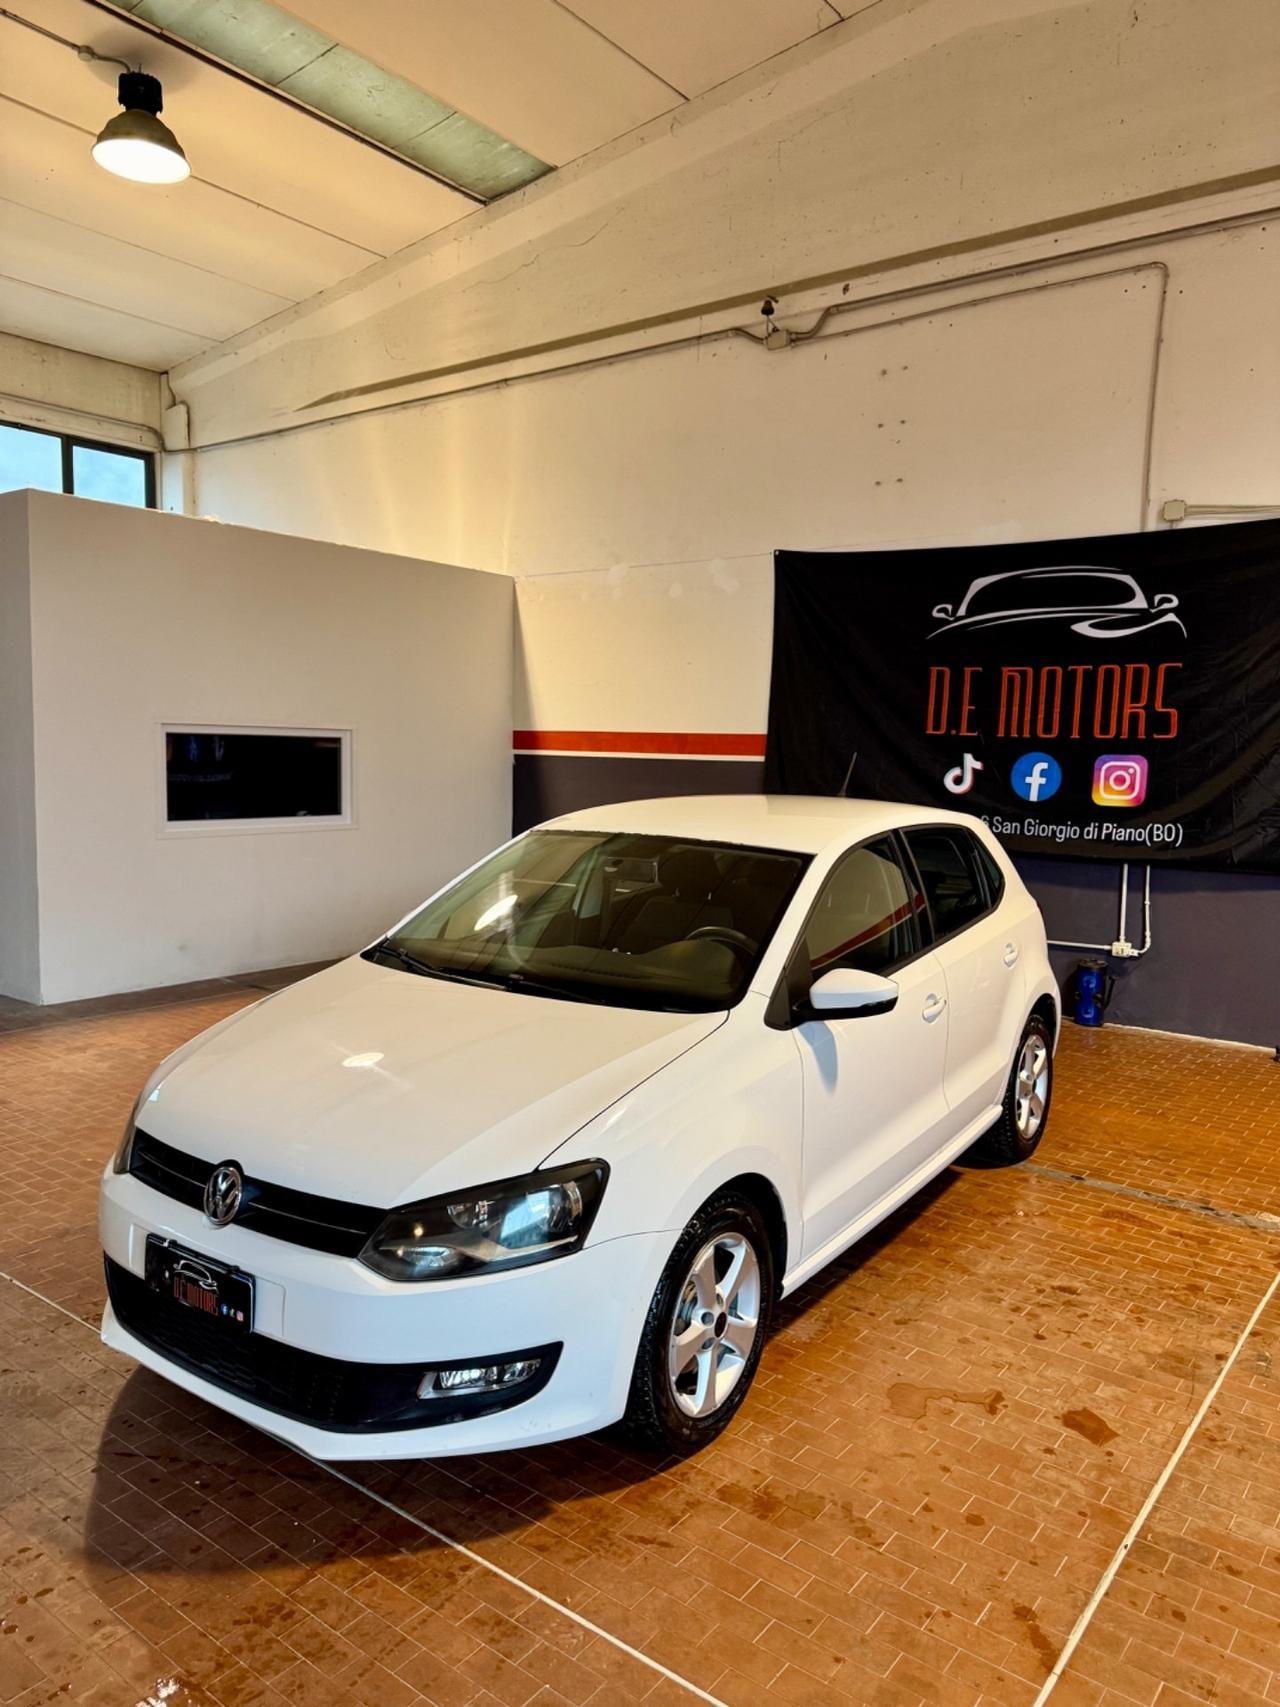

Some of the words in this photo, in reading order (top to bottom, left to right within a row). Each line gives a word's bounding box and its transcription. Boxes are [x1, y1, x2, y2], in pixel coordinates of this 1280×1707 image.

[926, 666, 982, 736] D.E
[997, 664, 1182, 739] MOTORS
[992, 816, 1021, 835] San
[1024, 818, 1080, 843] Giorgio
[1083, 822, 1098, 840] di
